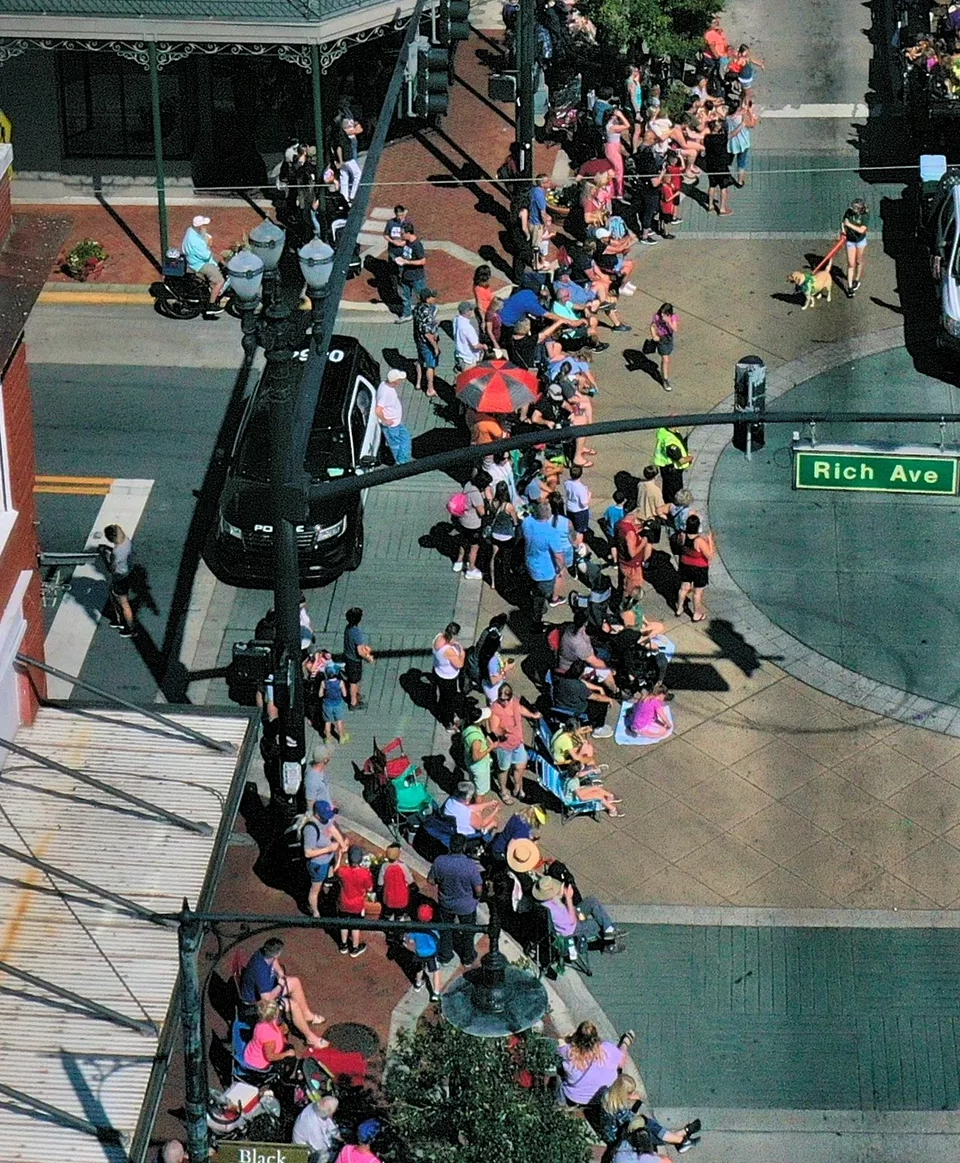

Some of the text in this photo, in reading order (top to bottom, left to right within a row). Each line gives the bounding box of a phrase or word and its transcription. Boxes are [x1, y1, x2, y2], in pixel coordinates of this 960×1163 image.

[813, 460, 939, 484] Rich Ave
[253, 524, 305, 533] POE
[239, 1148, 287, 1163] Black
